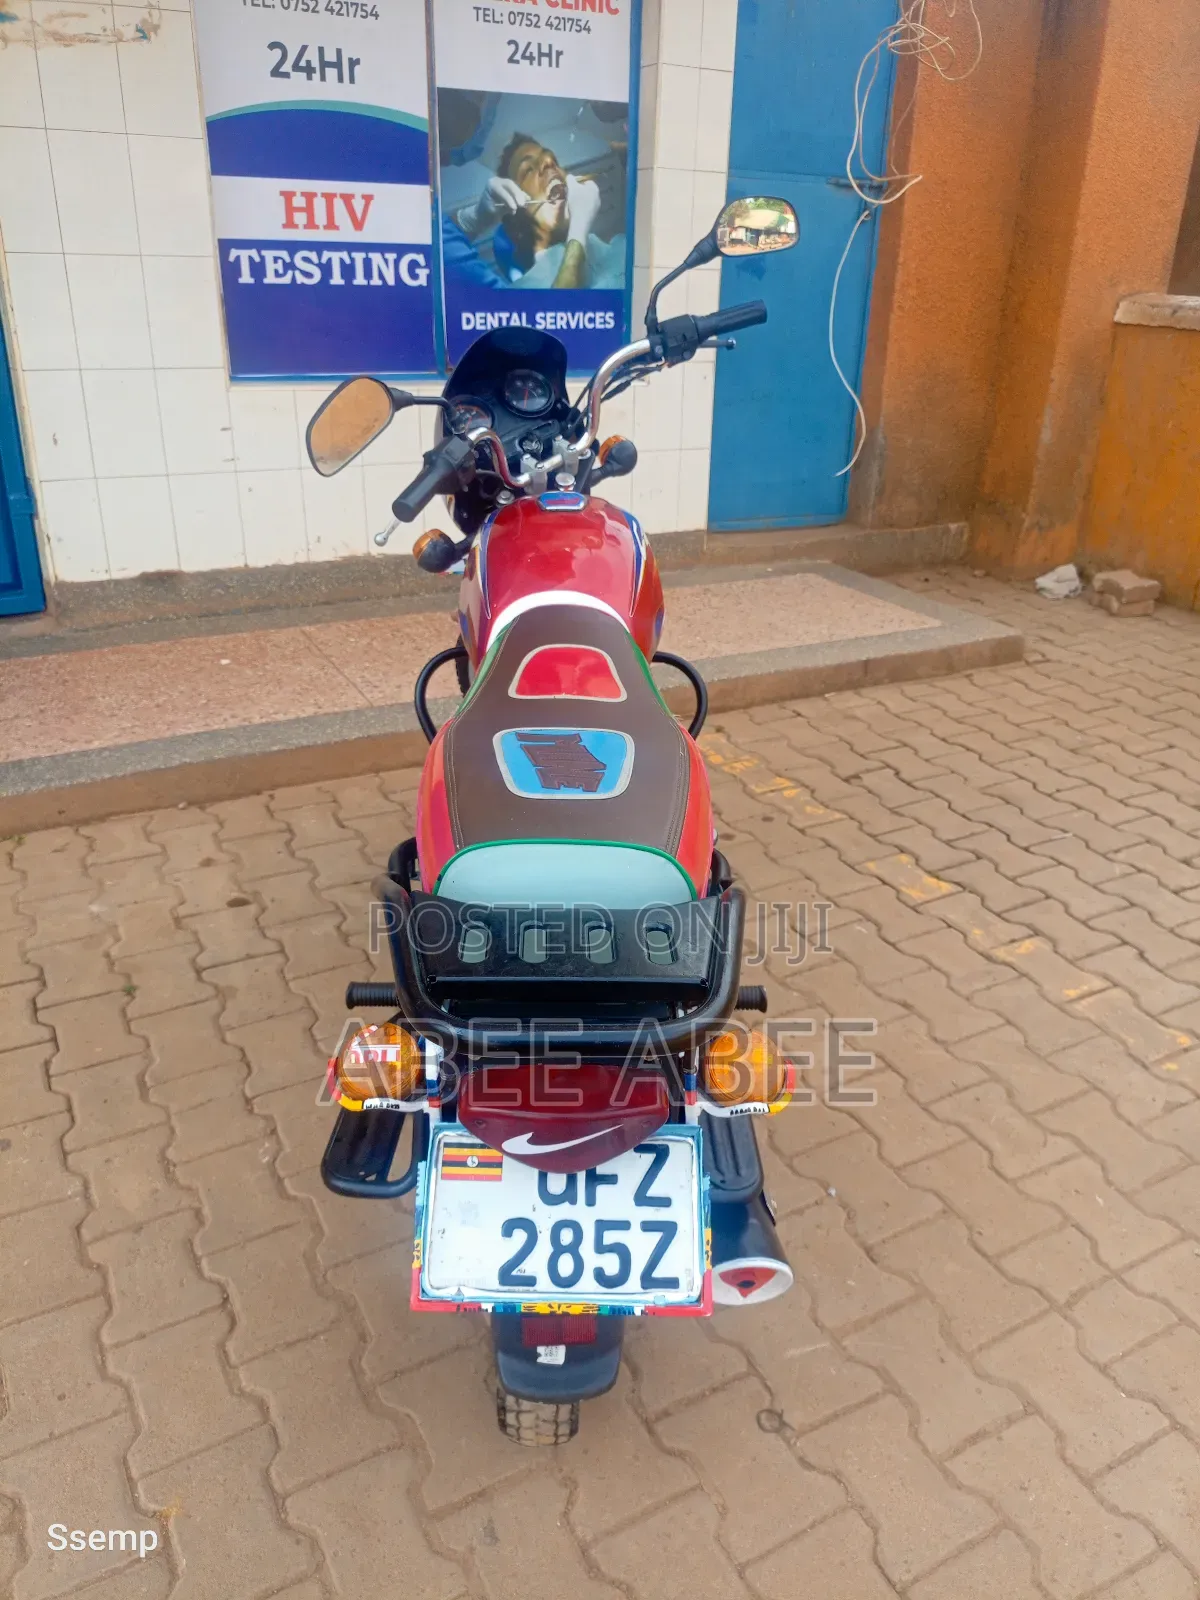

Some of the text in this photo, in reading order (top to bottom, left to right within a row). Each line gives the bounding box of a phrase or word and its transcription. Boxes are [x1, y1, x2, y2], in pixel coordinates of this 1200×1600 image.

[324, 0, 380, 20] 421754
[473, 7, 592, 34] TEL: 0752 421754
[267, 41, 360, 84] 24Hr
[506, 39, 564, 68] 24Hr
[280, 190, 374, 232] HIV
[228, 248, 430, 287] TESTING
[461, 312, 615, 331] DENTAL SERVICES
[498, 1217, 680, 1290] 285Z
